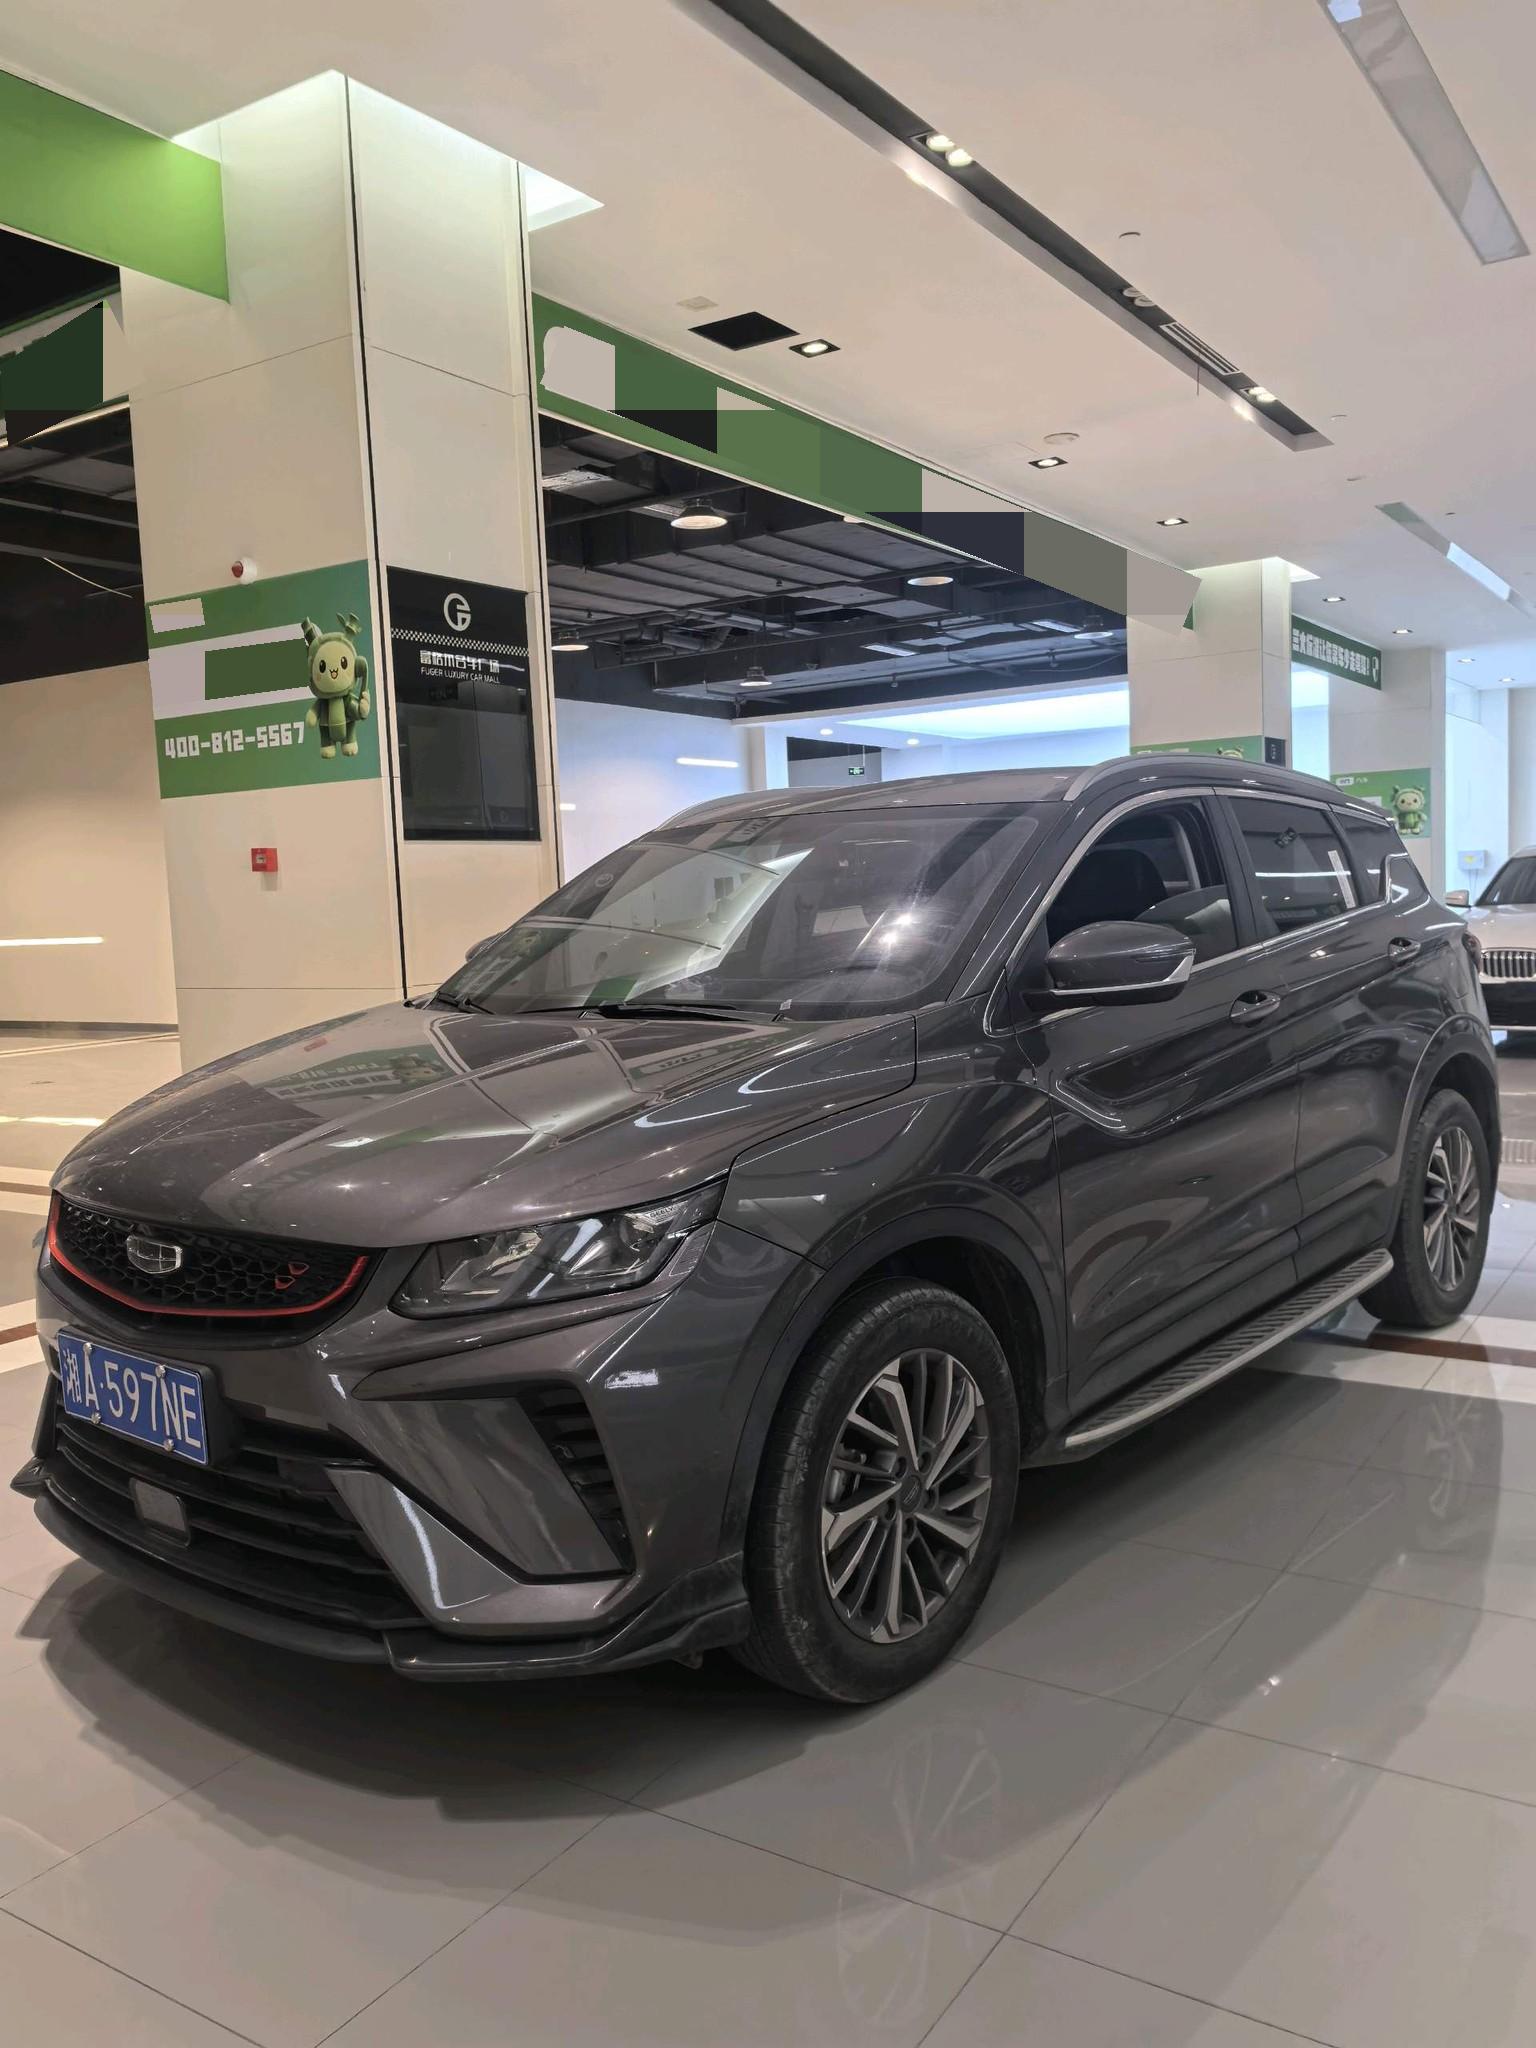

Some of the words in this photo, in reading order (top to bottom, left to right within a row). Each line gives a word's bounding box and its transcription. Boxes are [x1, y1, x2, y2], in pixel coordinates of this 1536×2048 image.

[420, 666, 443, 677] FUGER
[444, 670, 469, 680] LUXURY
[470, 673, 483, 683] CAR
[484, 675, 500, 685] MALL
[165, 721, 305, 759] 400-812-5567
